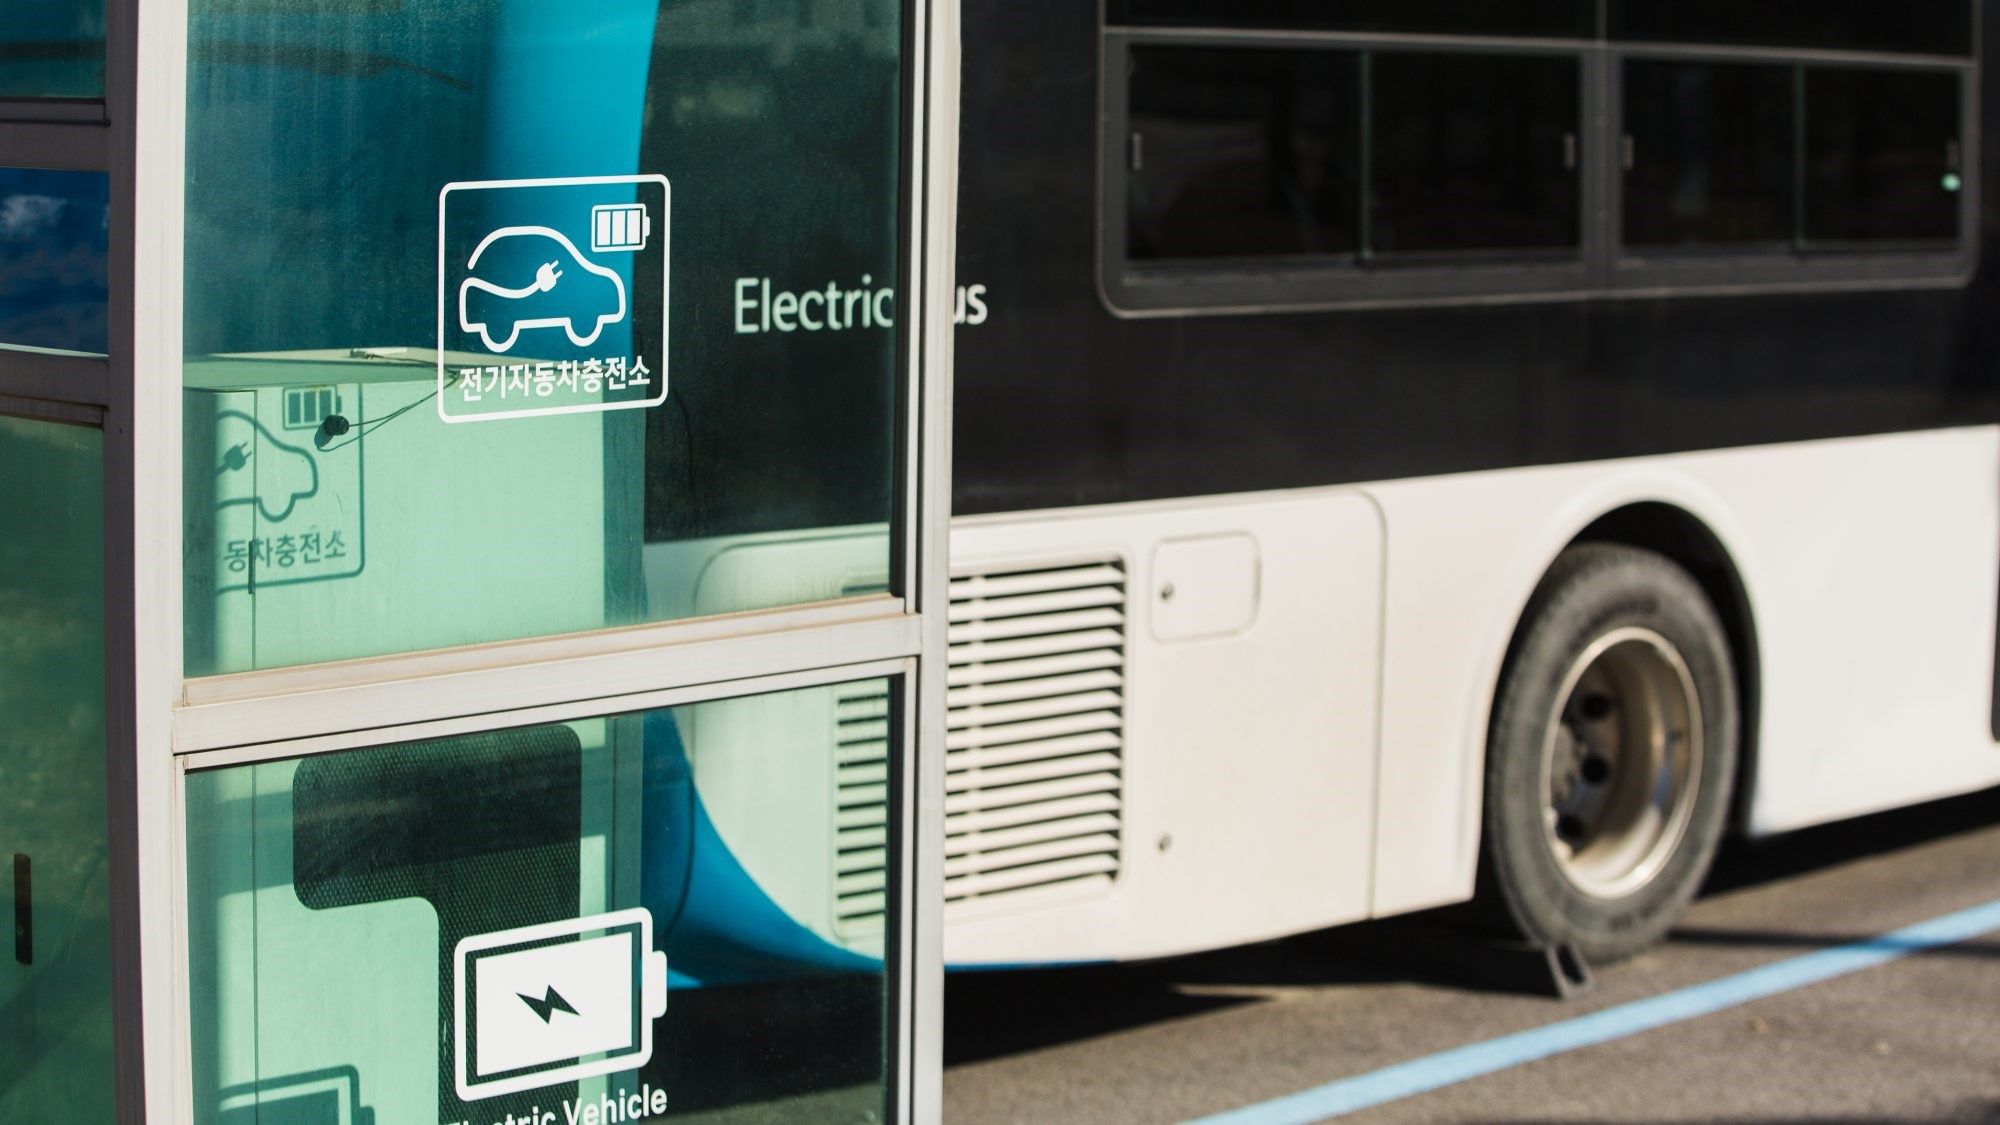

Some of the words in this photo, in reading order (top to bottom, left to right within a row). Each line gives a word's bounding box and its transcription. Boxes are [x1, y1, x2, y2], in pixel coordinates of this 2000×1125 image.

[734, 273, 894, 333] Electric
[458, 355, 651, 402] 전기자동차충전소
[562, 1083, 668, 1125] Vehicle
